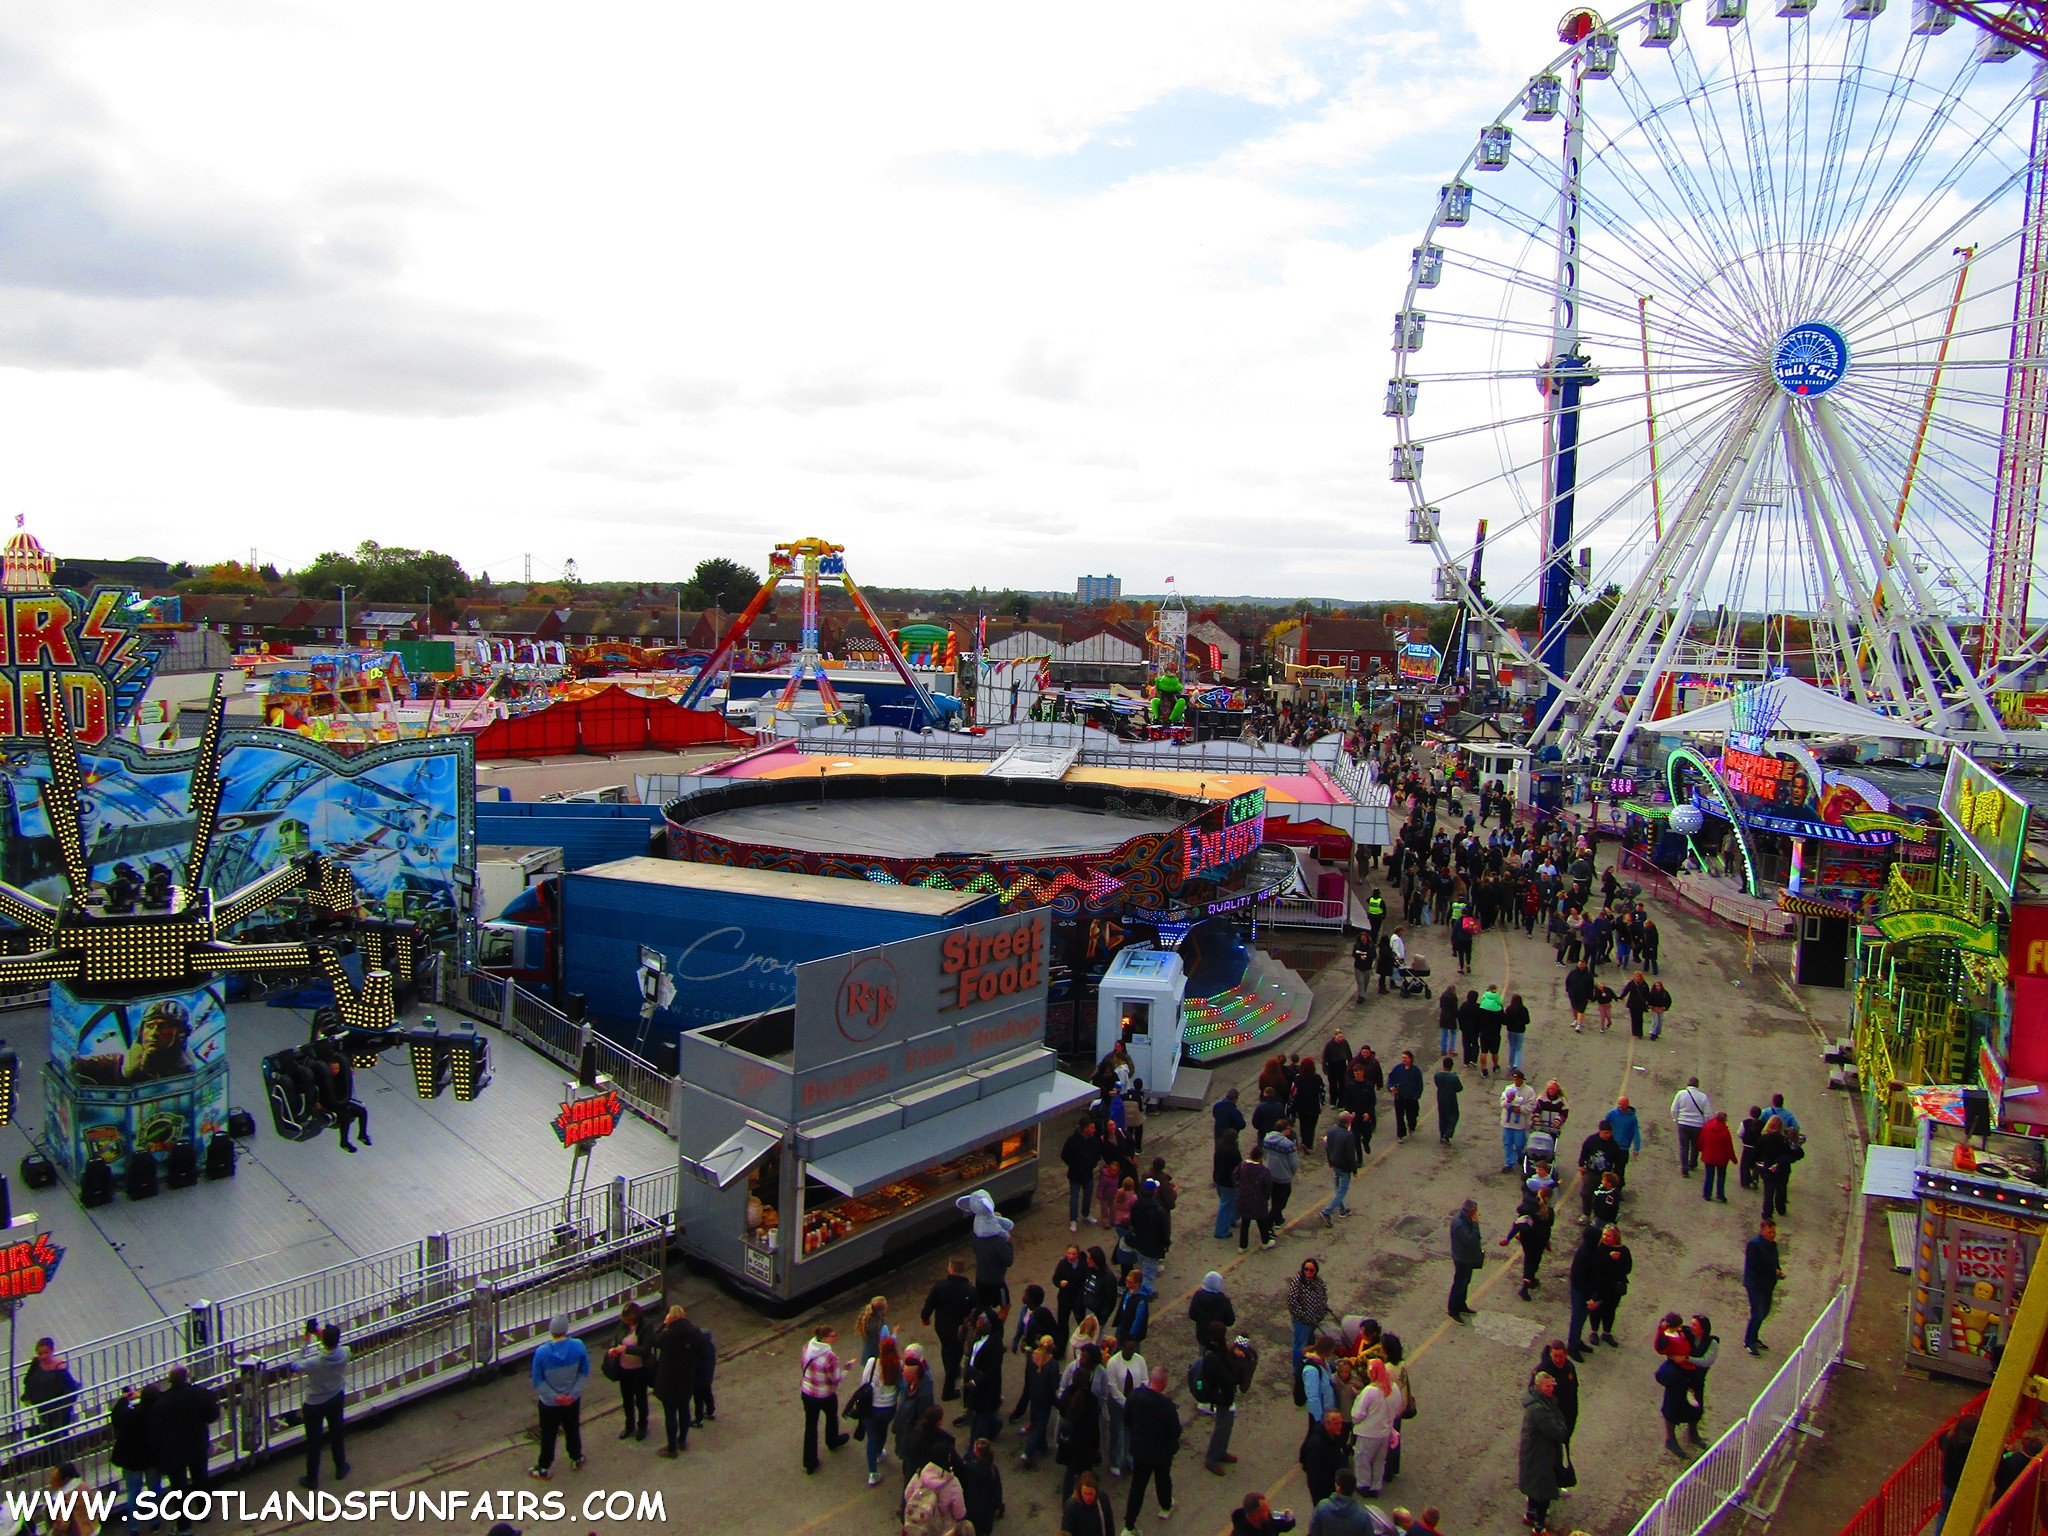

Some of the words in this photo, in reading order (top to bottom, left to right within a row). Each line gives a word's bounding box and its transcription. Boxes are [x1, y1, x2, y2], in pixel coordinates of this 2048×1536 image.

[1776, 364, 1804, 379] Hull
[1808, 365, 1839, 381] Fair
[1207, 896, 1251, 914] QUALITY
[943, 916, 1044, 974] Street
[2027, 941, 2048, 974] F
[958, 951, 1040, 1009] Food
[906, 1043, 956, 1074] Fries
[572, 1096, 607, 1122] AIR
[565, 1115, 614, 1147] RAID
[1958, 1261, 2006, 1279] BOX
